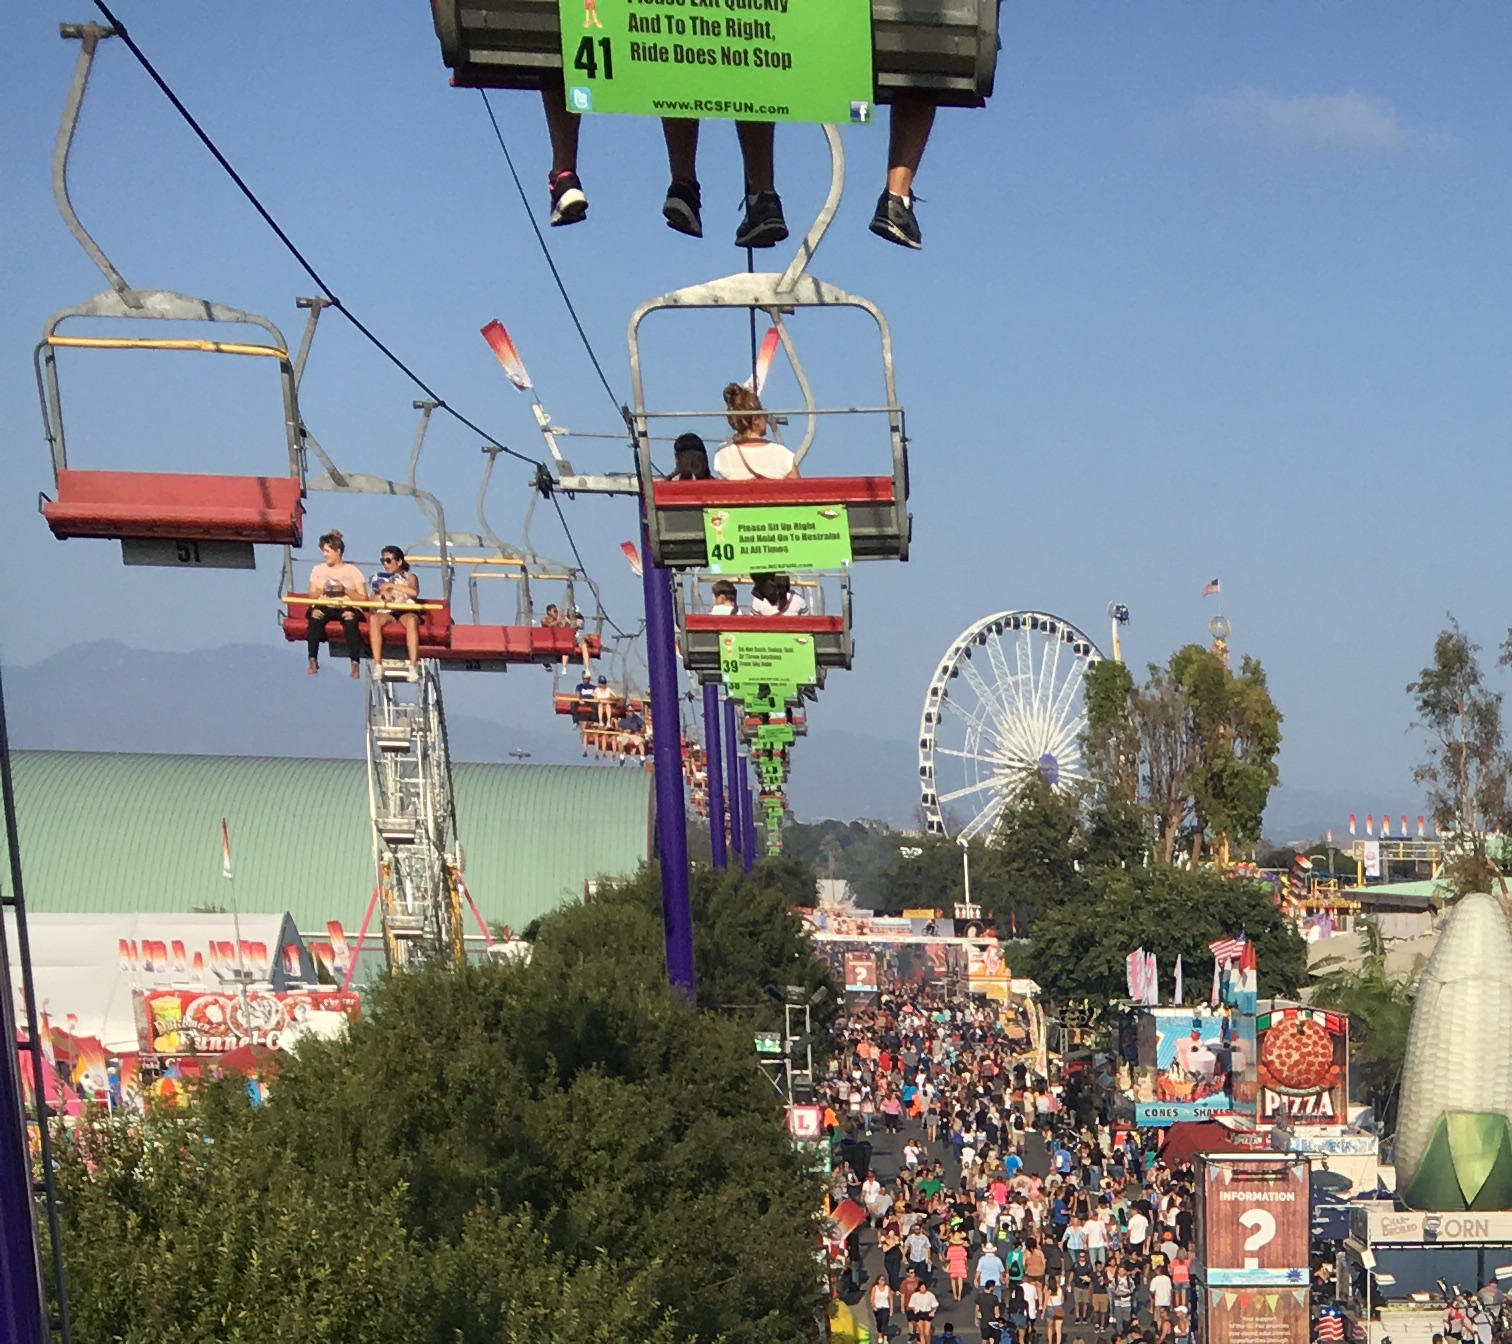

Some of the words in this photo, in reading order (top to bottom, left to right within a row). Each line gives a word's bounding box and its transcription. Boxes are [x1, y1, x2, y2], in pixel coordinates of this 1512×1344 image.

[628, 13, 661, 34] And
[664, 14, 685, 35] To
[690, 16, 721, 37] The
[726, 18, 776, 41] Right,
[574, 36, 613, 79] 41
[630, 42, 669, 62] Ride
[673, 44, 717, 65] Does
[721, 46, 749, 67] Not
[753, 48, 792, 70] Stop
[652, 99, 789, 115] www.RCSFUN.com
[738, 523, 766, 532] Please
[739, 535, 755, 543] And
[757, 534, 776, 542] Hold
[790, 533, 800, 541] To
[802, 532, 840, 541] Restraint
[711, 543, 735, 560] 40
[763, 545, 788, 553] Times
[723, 660, 738, 673] 39
[1264, 1088, 1334, 1116] PIZZA
[1144, 1108, 1179, 1117] CONES
[1220, 1191, 1295, 1202] INFORMATION
